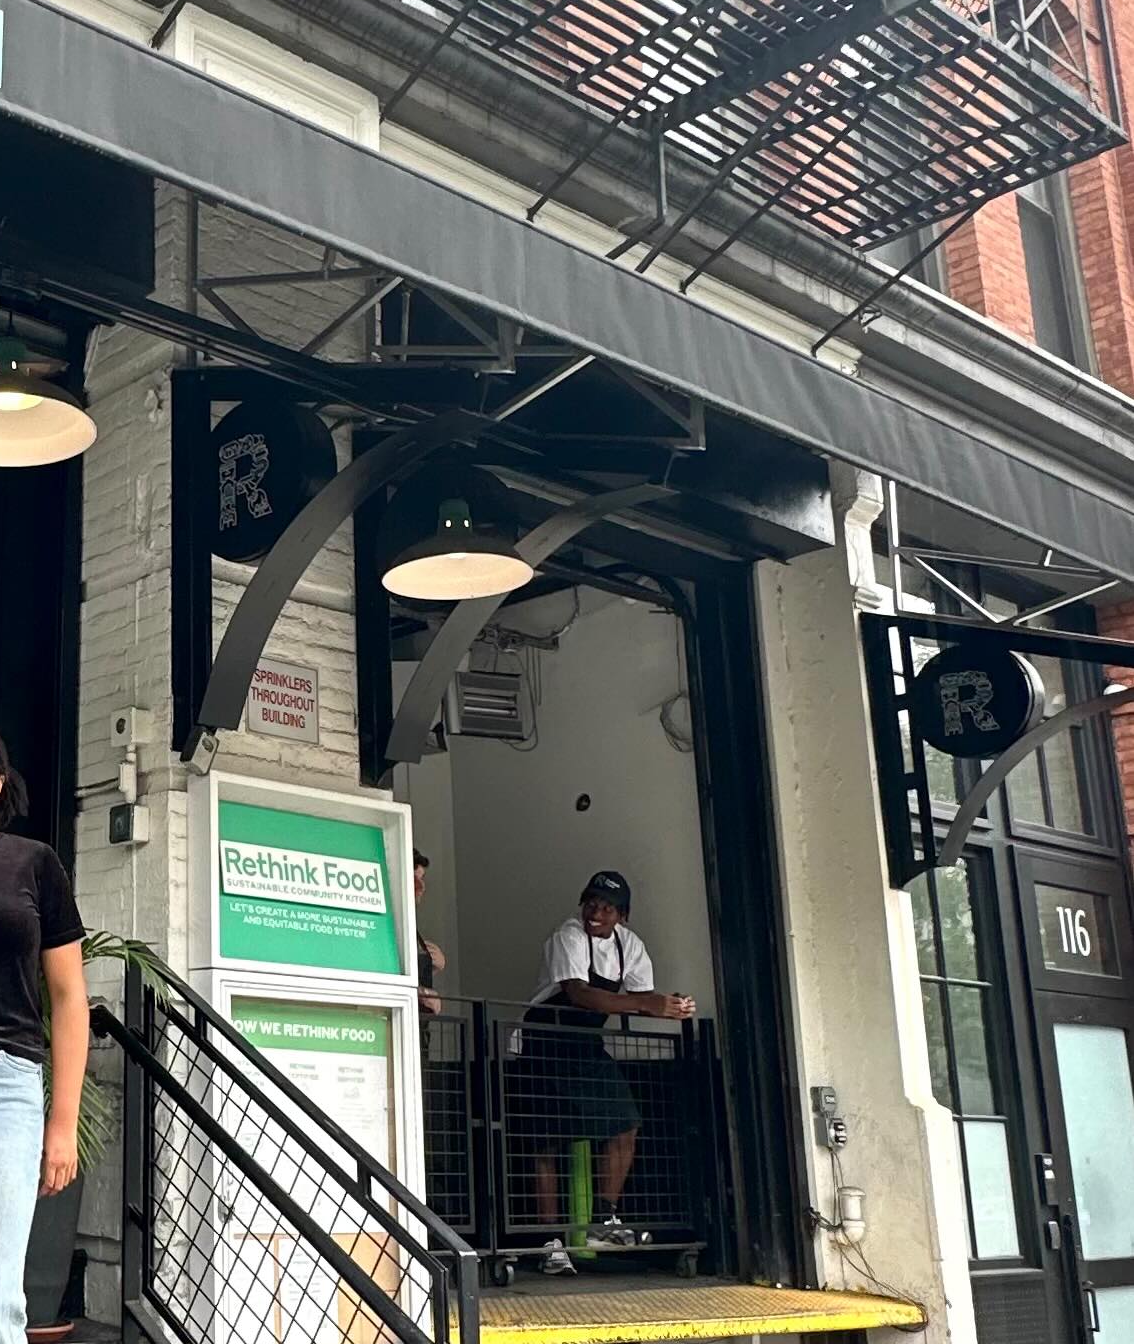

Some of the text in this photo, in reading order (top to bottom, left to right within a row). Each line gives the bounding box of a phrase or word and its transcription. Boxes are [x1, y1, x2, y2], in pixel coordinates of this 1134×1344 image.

[254, 668, 312, 694] SPRINKLERS
[251, 686, 315, 713] THROUGHOUT
[262, 708, 306, 729] BUILDING
[224, 847, 380, 894] Rethink Food
[226, 878, 289, 894] SUSTAINABLE
[346, 894, 382, 906] KITCHEN
[229, 902, 377, 930] LET'S CREATE A MORE SUSTAINABLE
[243, 915, 367, 939] AND EQUITABLE FOOD SYSTEM
[1056, 906, 1091, 957] 116
[232, 1019, 376, 1043] OW WE RETHINK FOOD
